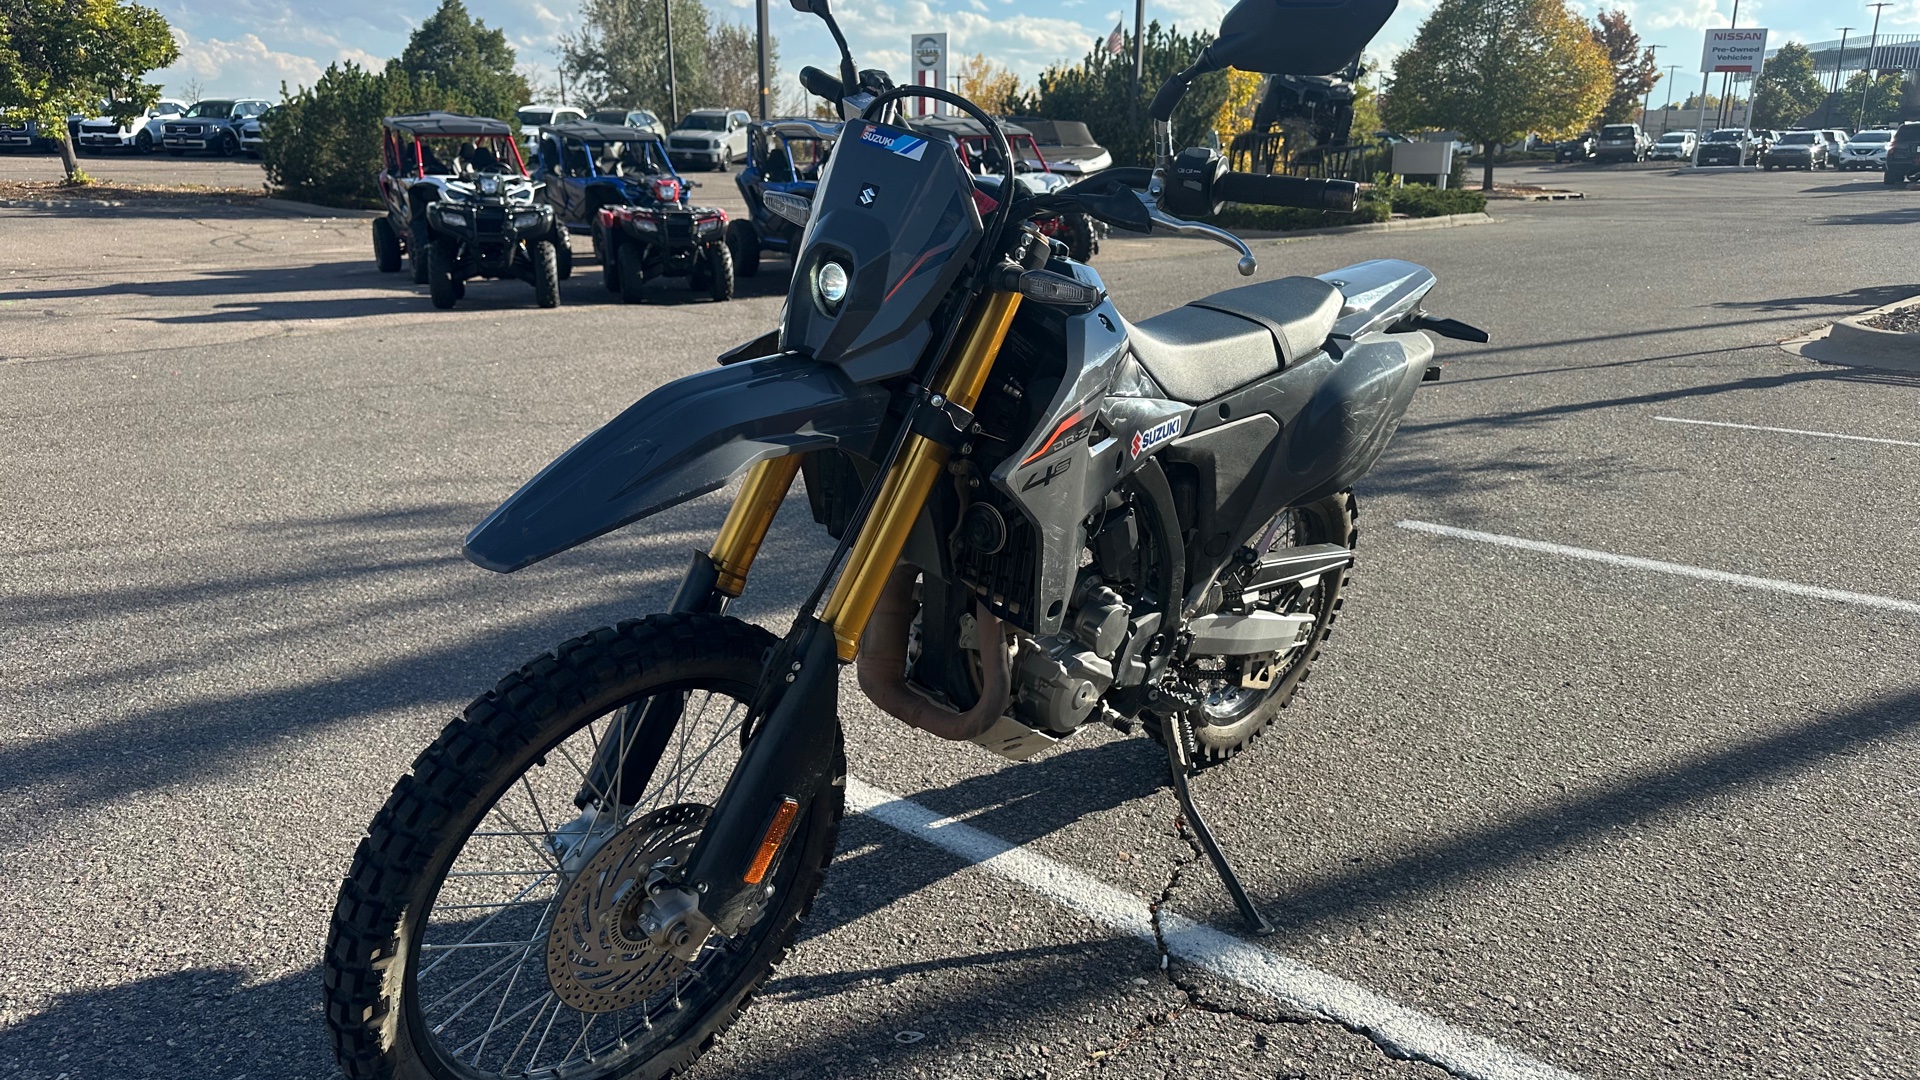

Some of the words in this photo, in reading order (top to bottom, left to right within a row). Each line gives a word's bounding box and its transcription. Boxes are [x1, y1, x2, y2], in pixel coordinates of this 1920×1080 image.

[1714, 33, 1762, 41] NISSAN
[862, 131, 895, 147] SUZUKI
[1052, 427, 1088, 451] DR-Z
[1142, 417, 1180, 449] SUZUKI
